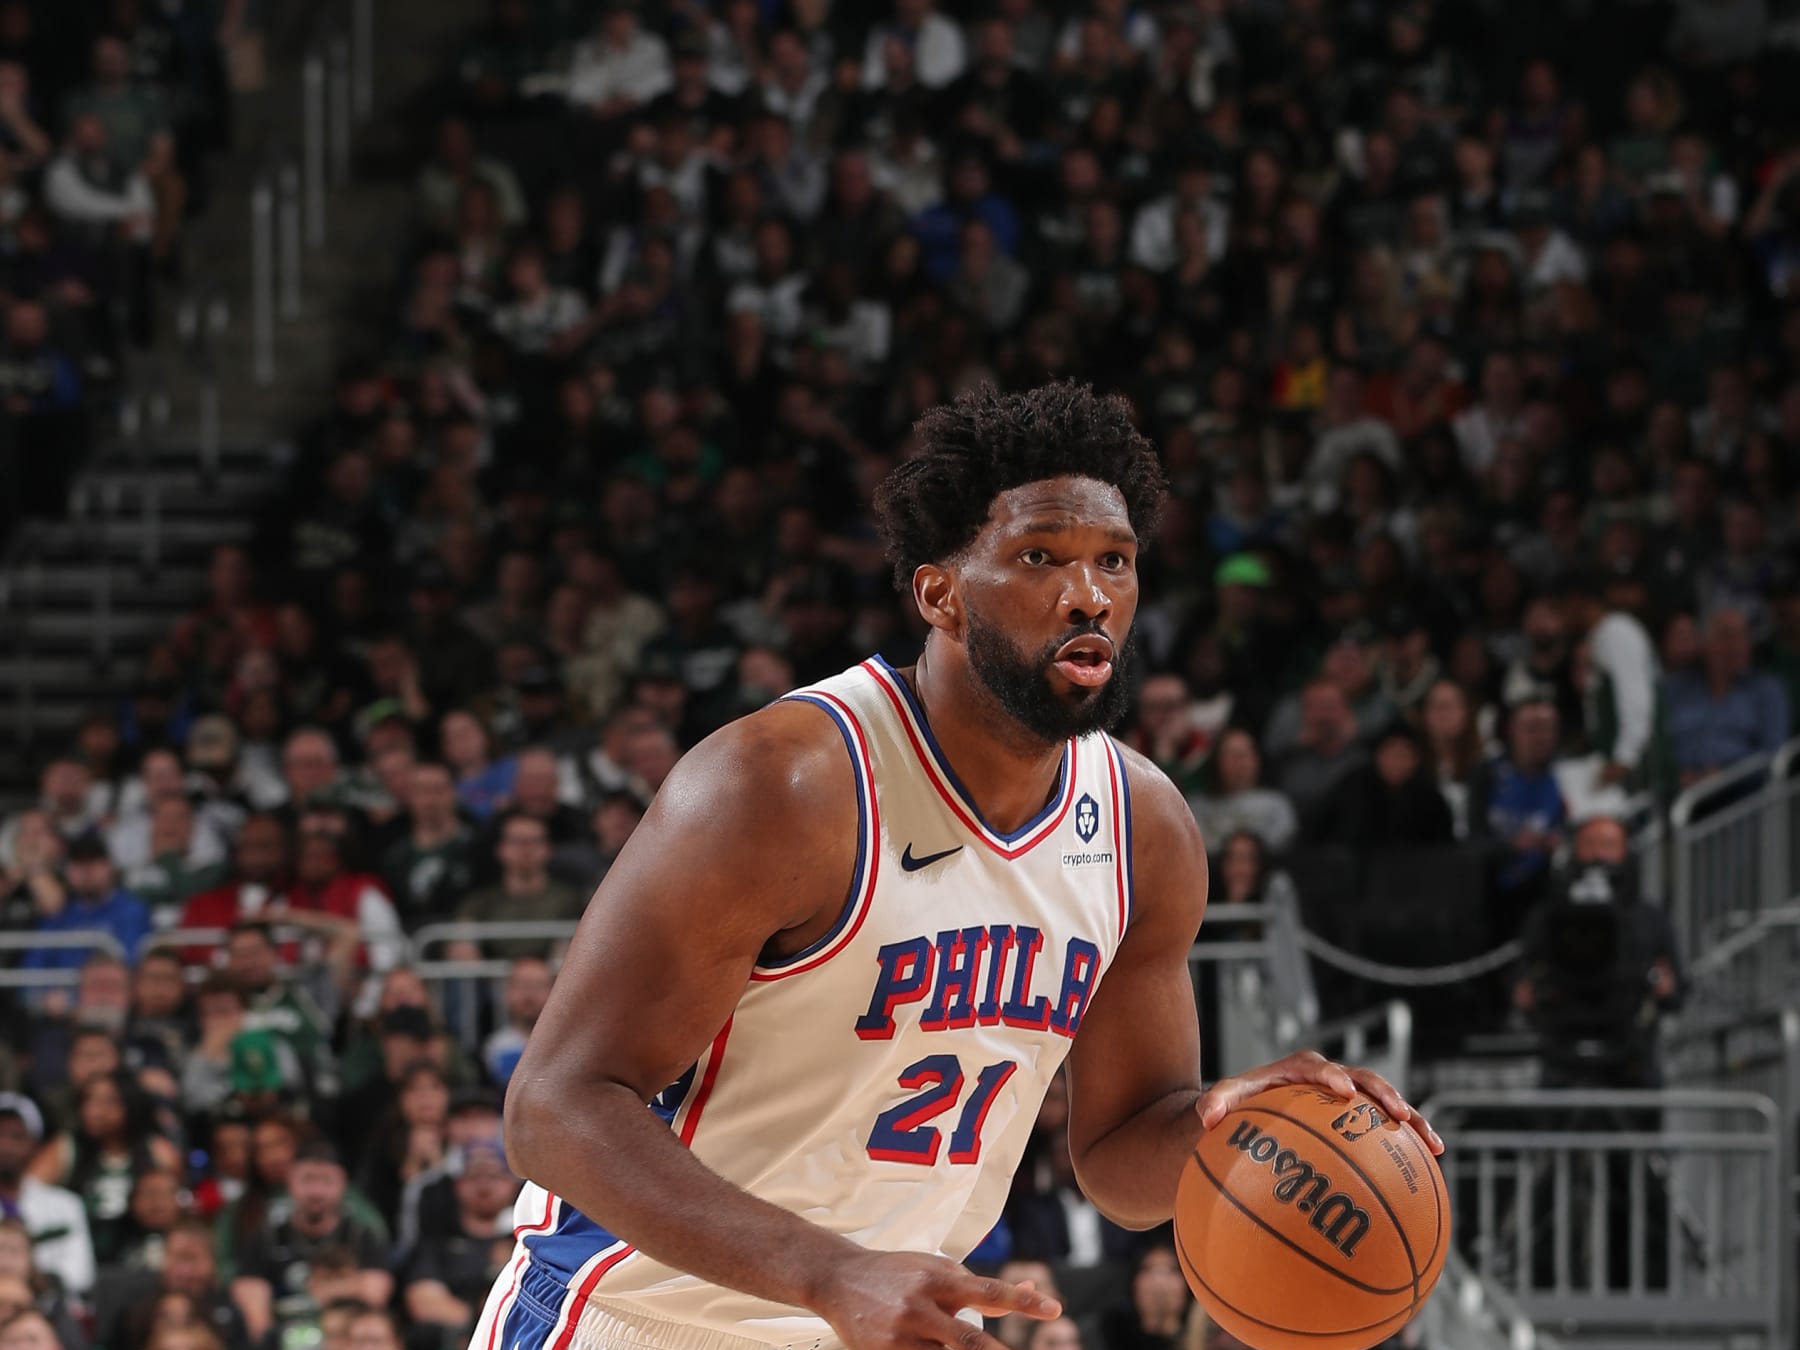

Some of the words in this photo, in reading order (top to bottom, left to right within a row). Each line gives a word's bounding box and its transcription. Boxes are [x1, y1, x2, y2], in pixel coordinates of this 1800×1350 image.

[1062, 852, 1113, 867] crypto.com
[854, 924, 1101, 1041] PHILA
[866, 1054, 1017, 1167] 21
[1227, 1119, 1371, 1261] Wilson
